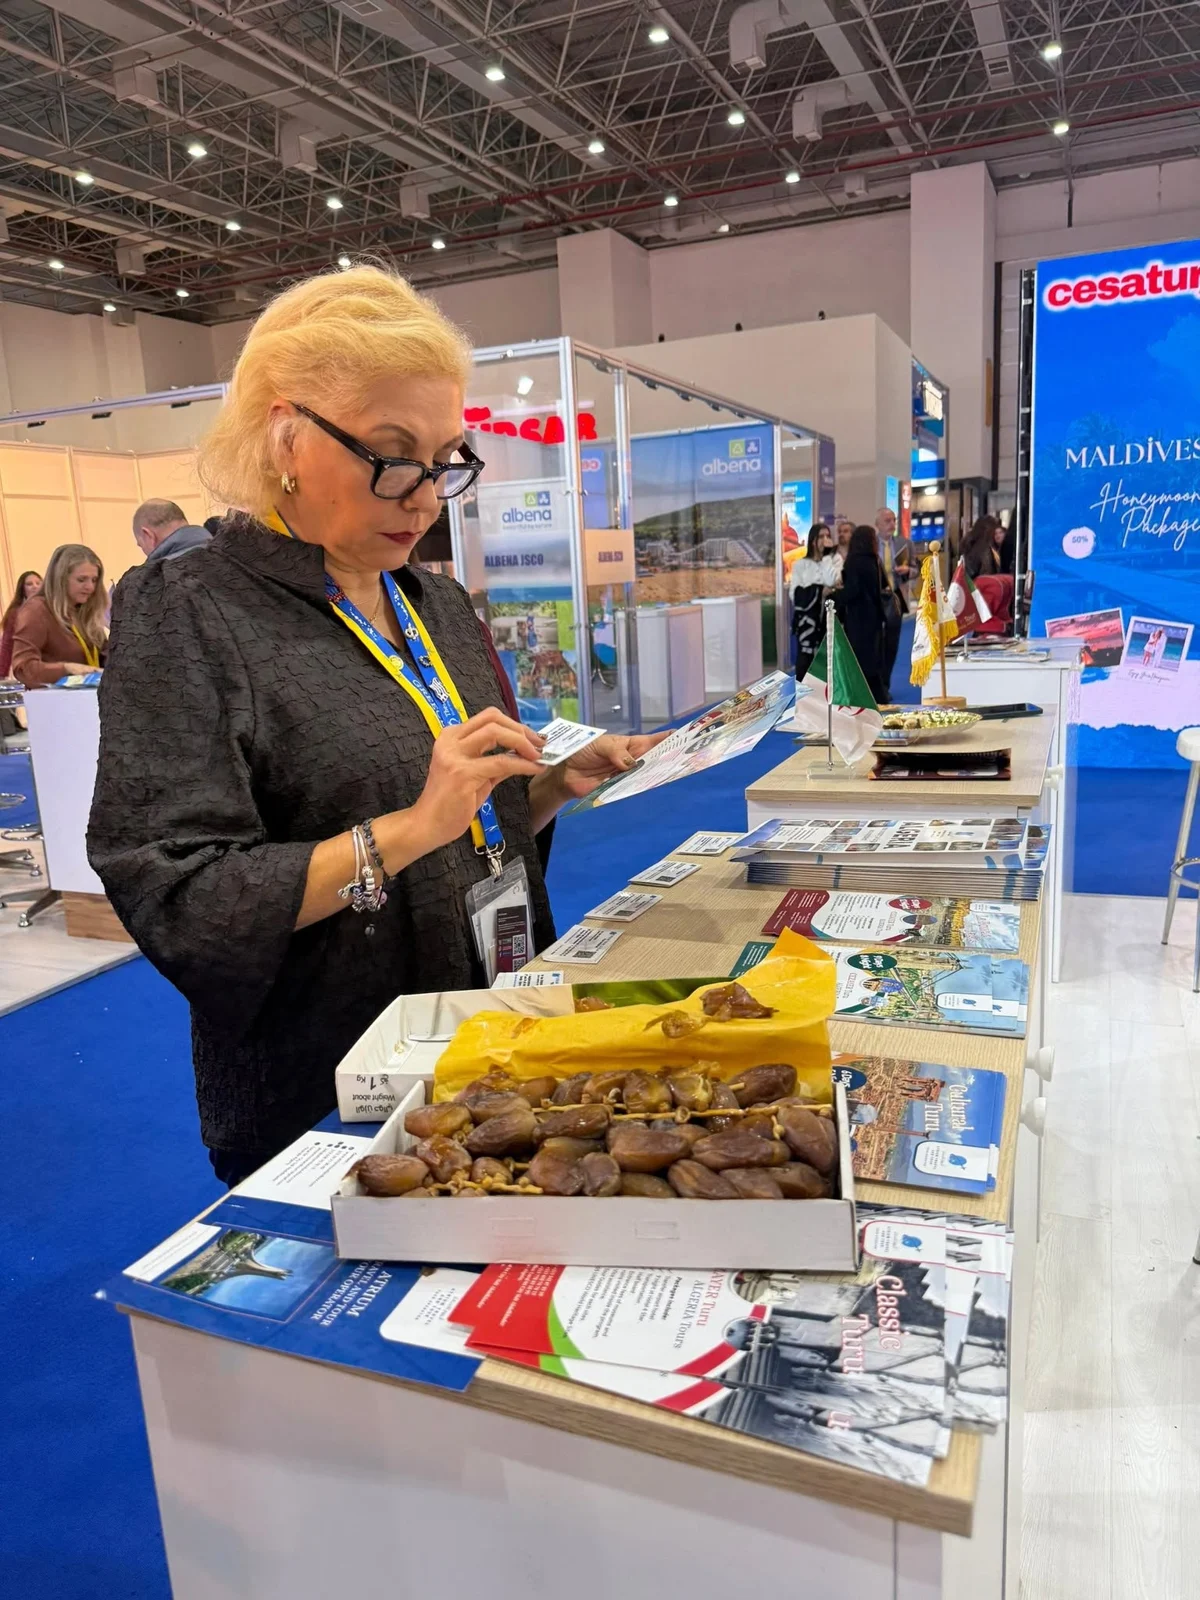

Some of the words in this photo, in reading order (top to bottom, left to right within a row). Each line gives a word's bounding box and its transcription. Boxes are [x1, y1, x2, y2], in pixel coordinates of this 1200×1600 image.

[702, 458, 761, 476] albena
[502, 508, 551, 523] albena
[484, 556, 519, 568] ALBENA
[883, 821, 925, 849] ALGERIA
[357, 1075, 366, 1083] Kg
[370, 1077, 376, 1090] 1
[372, 1094, 395, 1103] Weight
[949, 1084, 975, 1131] Cultural
[924, 1103, 944, 1131] Turu
[309, 1278, 354, 1320] OPERATOR
[340, 1285, 362, 1303] AND
[346, 1270, 393, 1317] ATRIUM
[682, 1280, 706, 1320] ALGERIA
[318, 1302, 347, 1326] TOUR
[696, 1301, 716, 1326] Turu
[876, 1275, 908, 1350] Classic
[673, 1321, 692, 1349] Tours
[841, 1313, 871, 1373] Turu
